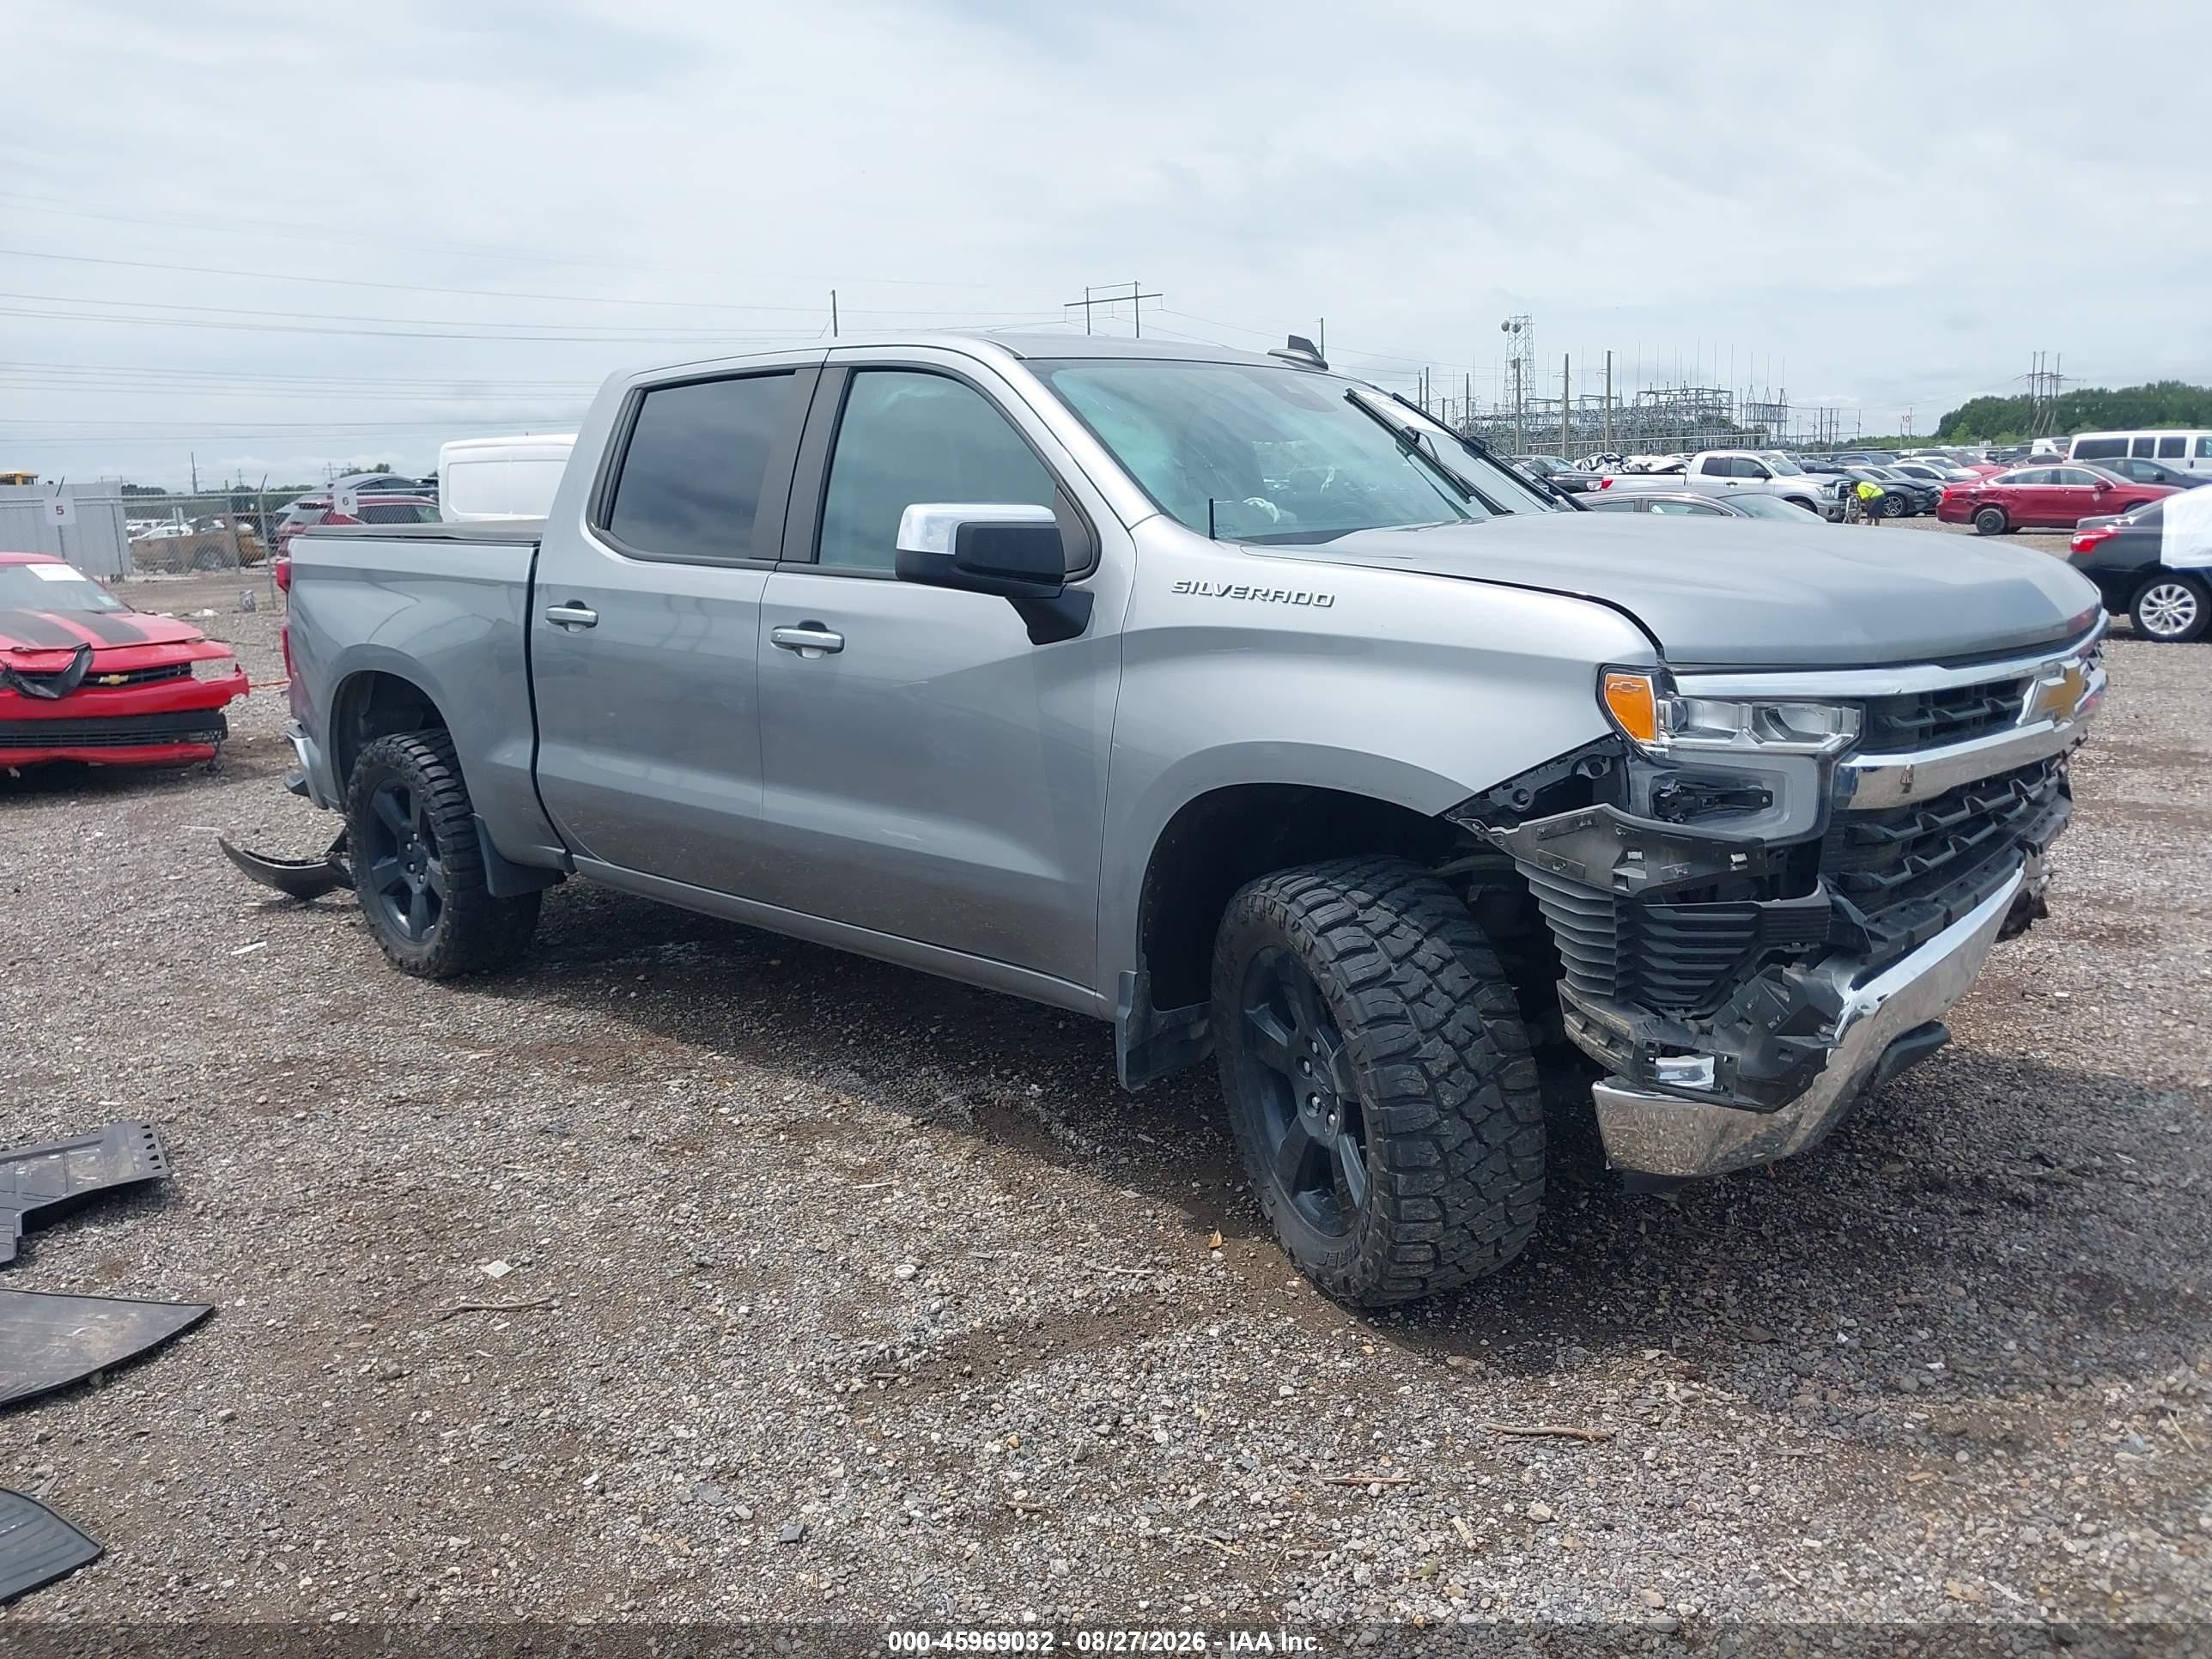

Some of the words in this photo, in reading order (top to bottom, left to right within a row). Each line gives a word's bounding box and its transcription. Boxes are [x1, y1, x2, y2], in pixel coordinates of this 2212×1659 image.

[342, 496, 349, 506] 6
[55, 505, 64, 515] 5
[1171, 580, 1335, 608] SILVERADO
